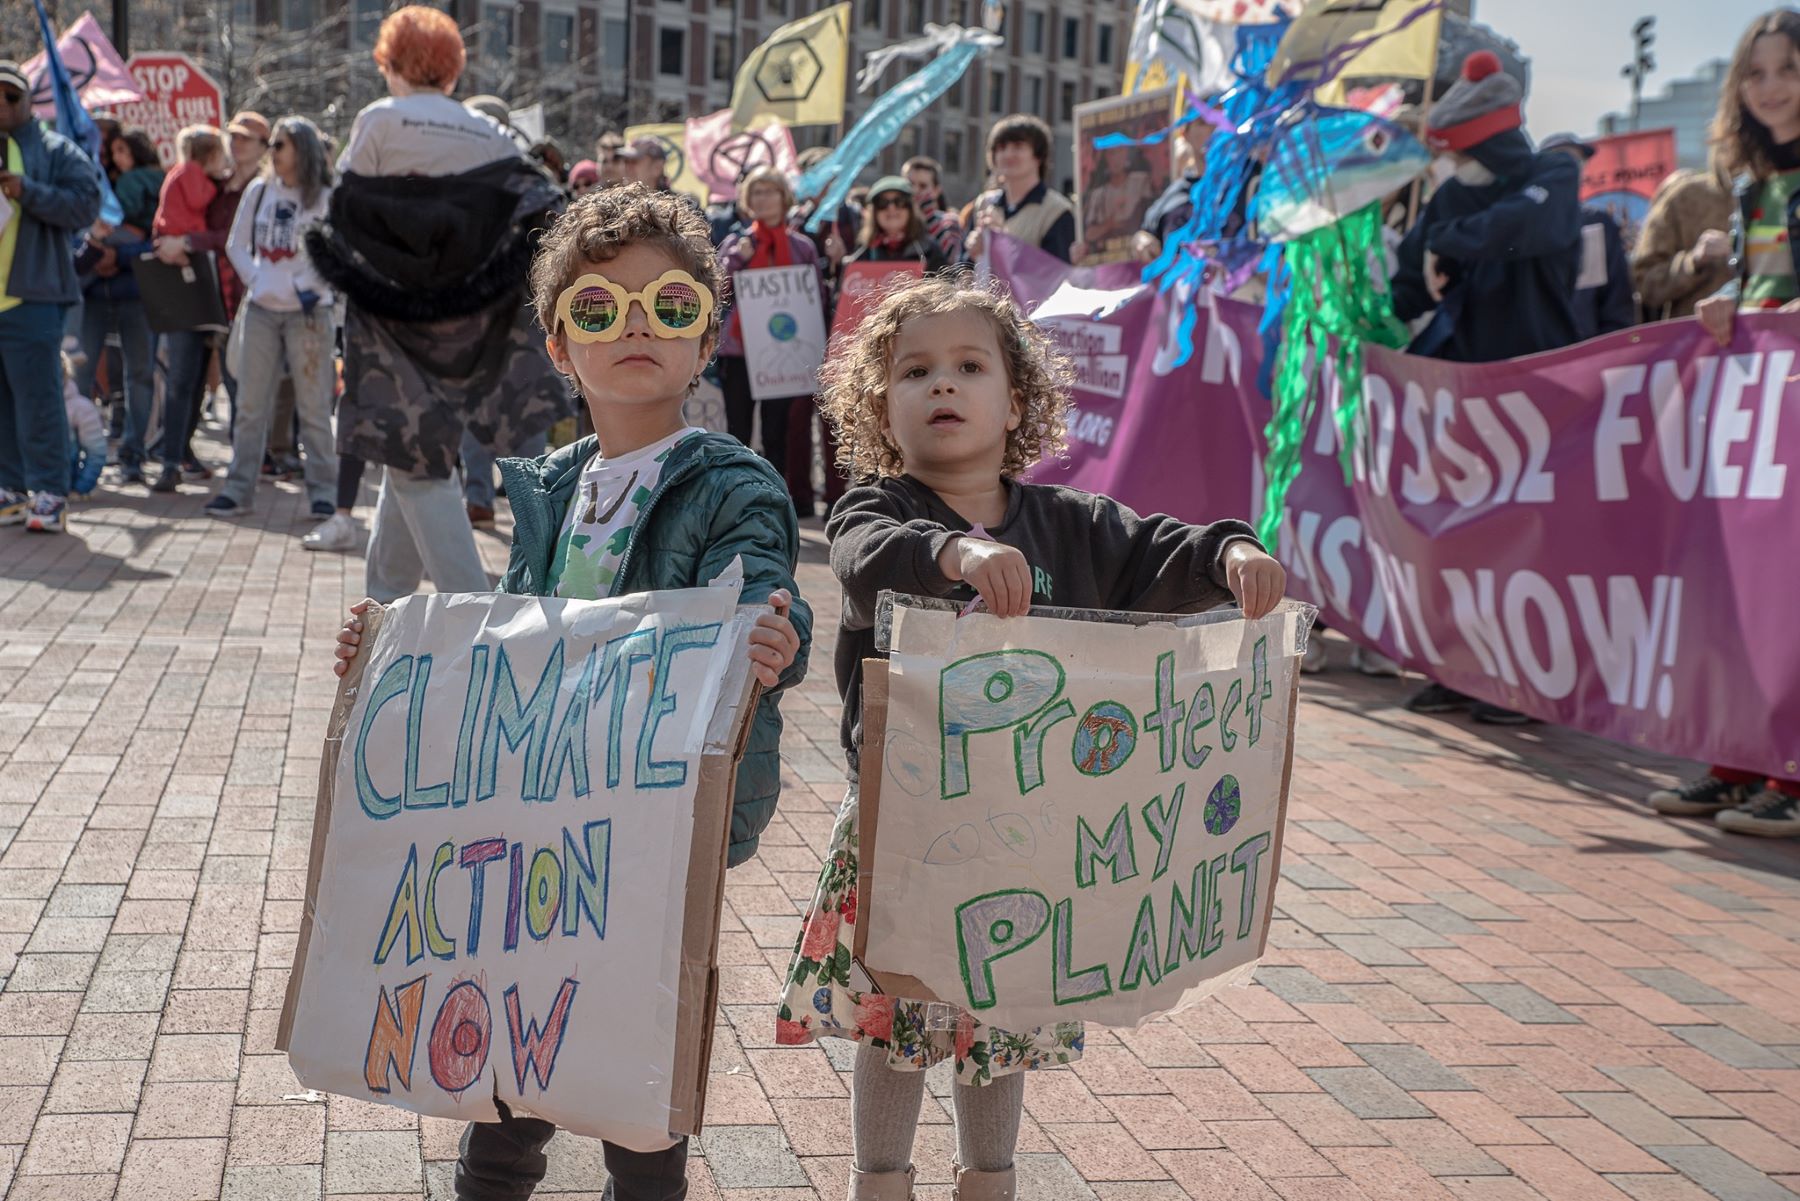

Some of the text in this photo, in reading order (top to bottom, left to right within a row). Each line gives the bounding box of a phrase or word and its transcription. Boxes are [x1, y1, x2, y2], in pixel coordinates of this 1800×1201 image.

[131, 64, 190, 93] STOP
[738, 268, 816, 302] PLASTIC
[1598, 349, 1796, 502] FUEL
[939, 635, 1272, 800] Protect
[1441, 568, 1683, 719] NOW!
[354, 622, 723, 820] CLIMATE
[373, 817, 612, 967] ACTION
[1075, 781, 1186, 889] MY
[954, 830, 1271, 1011] PLANET
[363, 972, 582, 1097] NOW
